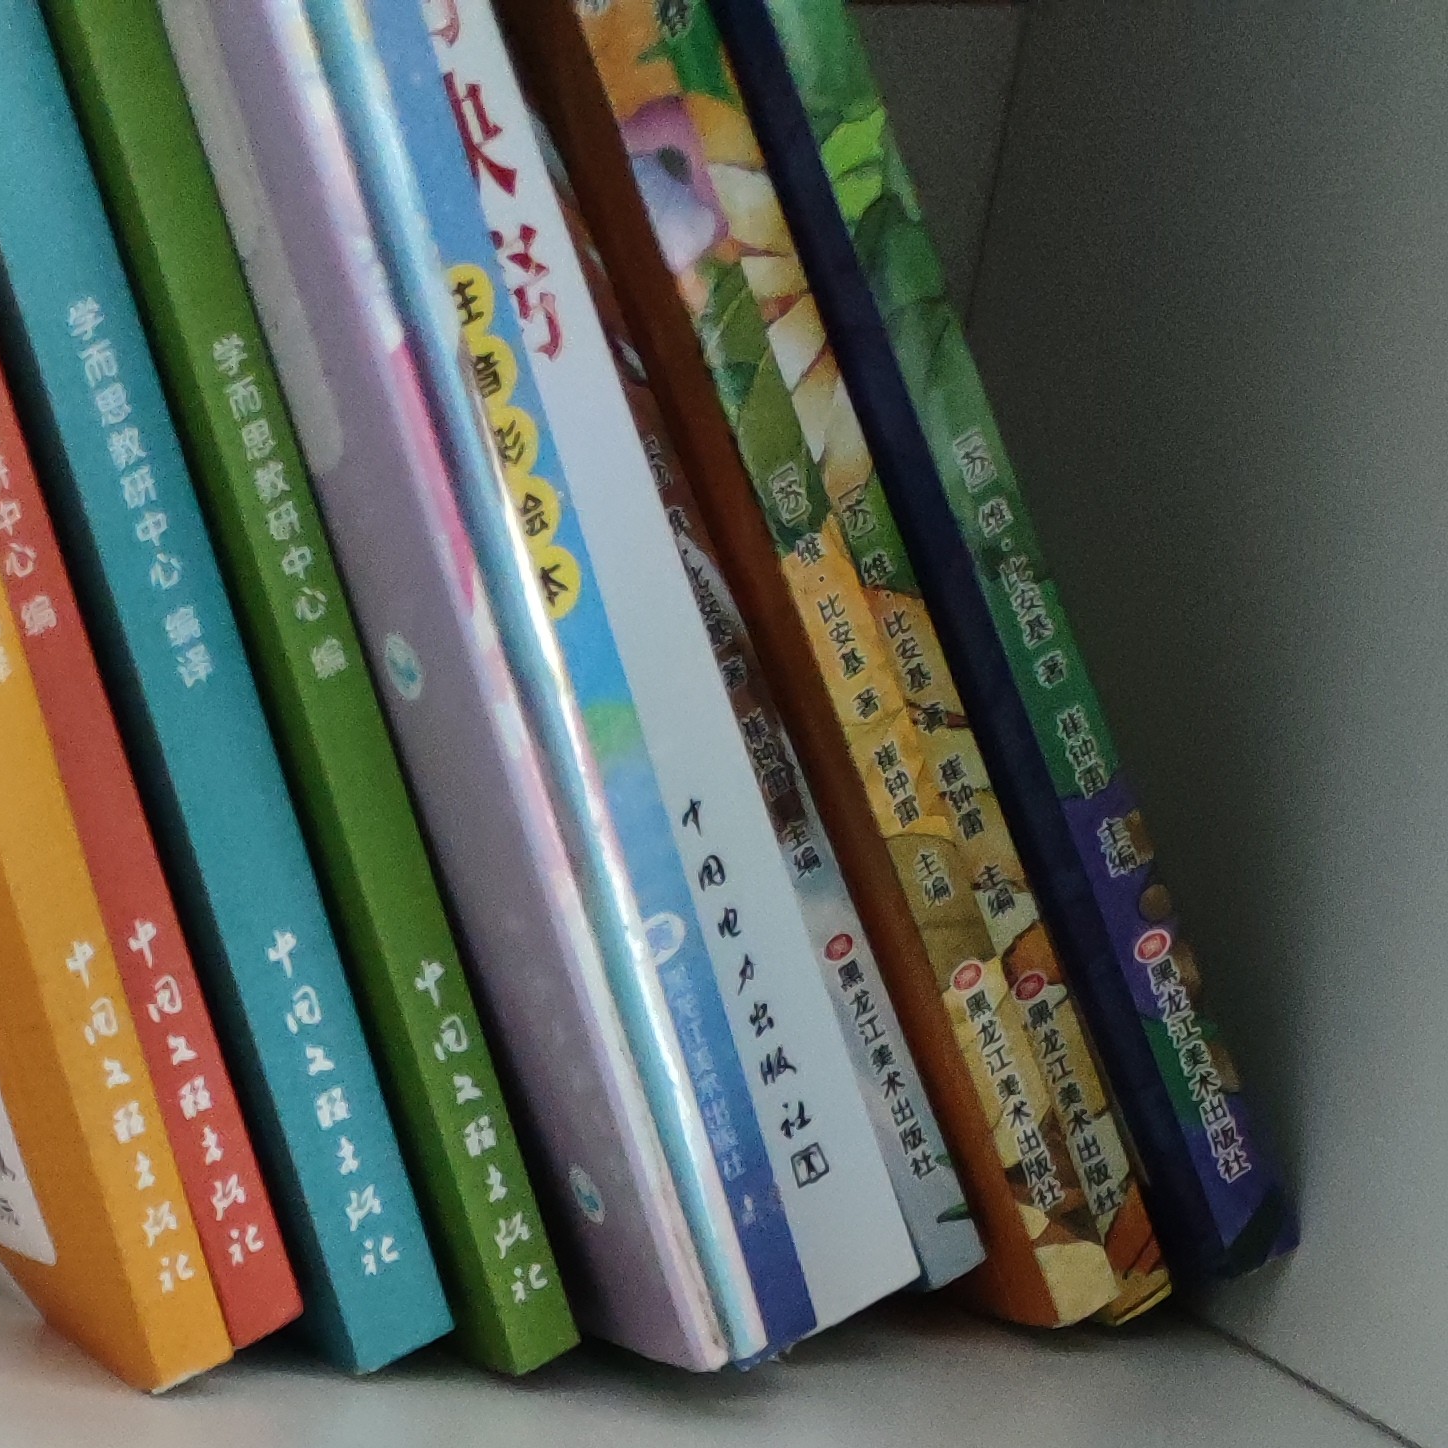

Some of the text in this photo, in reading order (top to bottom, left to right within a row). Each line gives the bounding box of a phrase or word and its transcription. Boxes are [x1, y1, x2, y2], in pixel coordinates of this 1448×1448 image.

[69, 297, 182, 590] 学而思教研中心
[212, 333, 328, 622] 学而思教研中心
[781, 826, 823, 879] 主编
[872, 739, 922, 830] 崔钟雷
[915, 851, 955, 907] 主编
[937, 752, 986, 842] 崔钟雷
[973, 862, 1017, 921] 主编
[1056, 704, 1108, 798] 崔钟雷
[1097, 815, 1139, 880] 主编
[835, 959, 937, 1181] 黑龙江美术出版社
[961, 992, 1065, 1212] 黑龙江美术出版社
[1024, 997, 1124, 1215] 黑龙江美术出版社
[1145, 955, 1253, 1181] 黑龙江美术出版社
